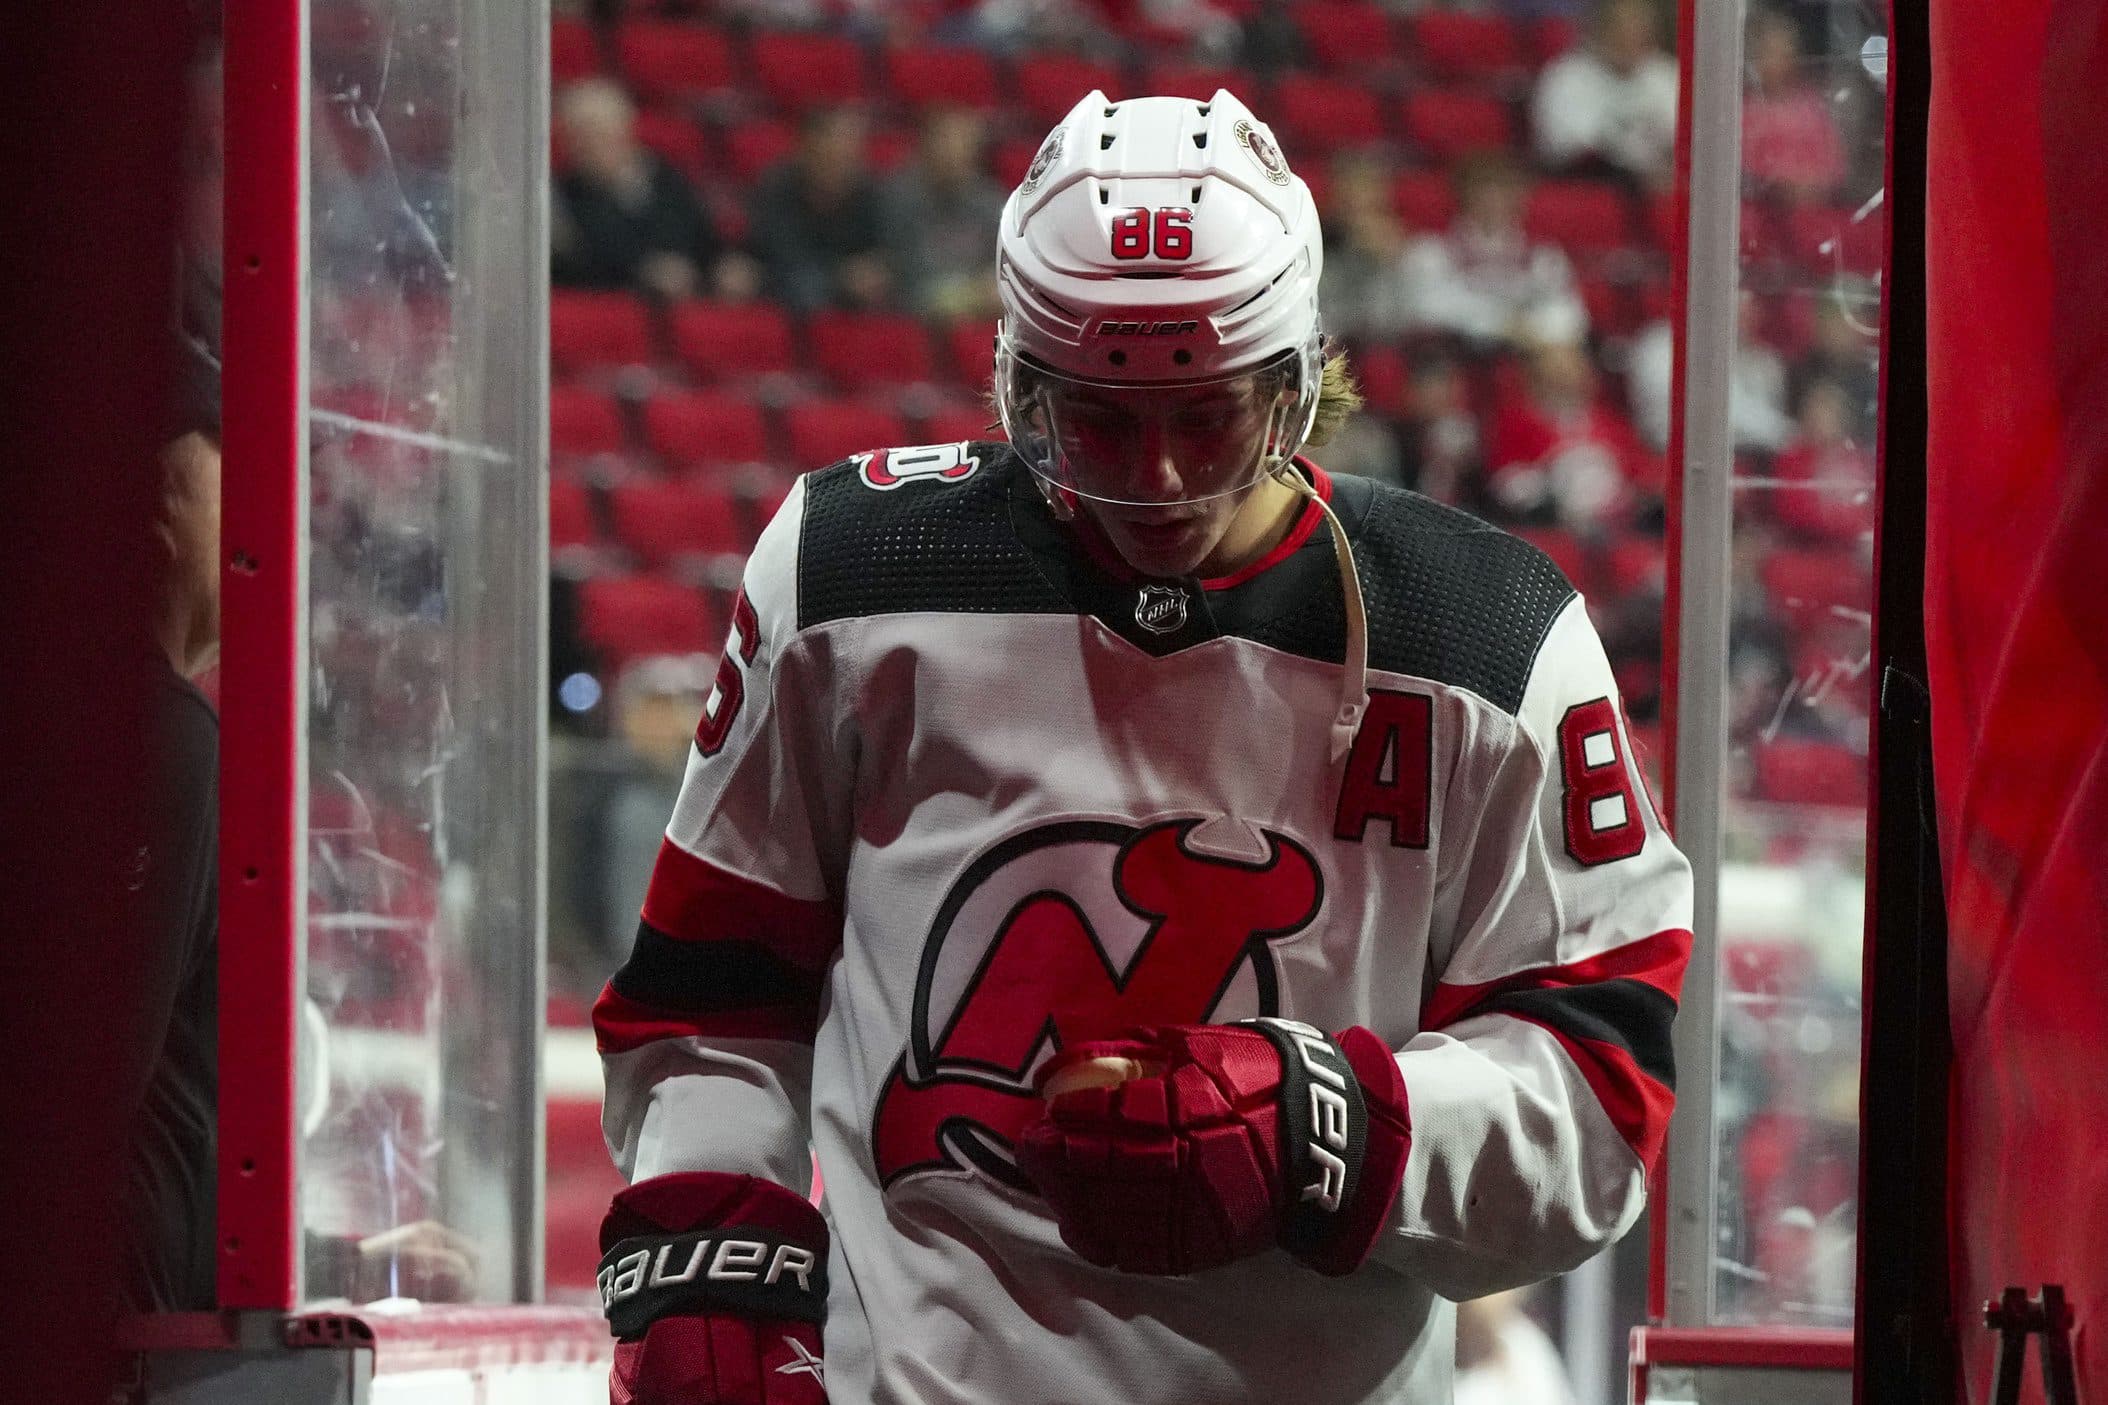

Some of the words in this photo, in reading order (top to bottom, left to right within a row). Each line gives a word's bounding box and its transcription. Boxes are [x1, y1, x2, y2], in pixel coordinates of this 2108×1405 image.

[1111, 206, 1194, 260] 86
[1147, 598, 1179, 621] NHL
[1333, 688, 1434, 850] A
